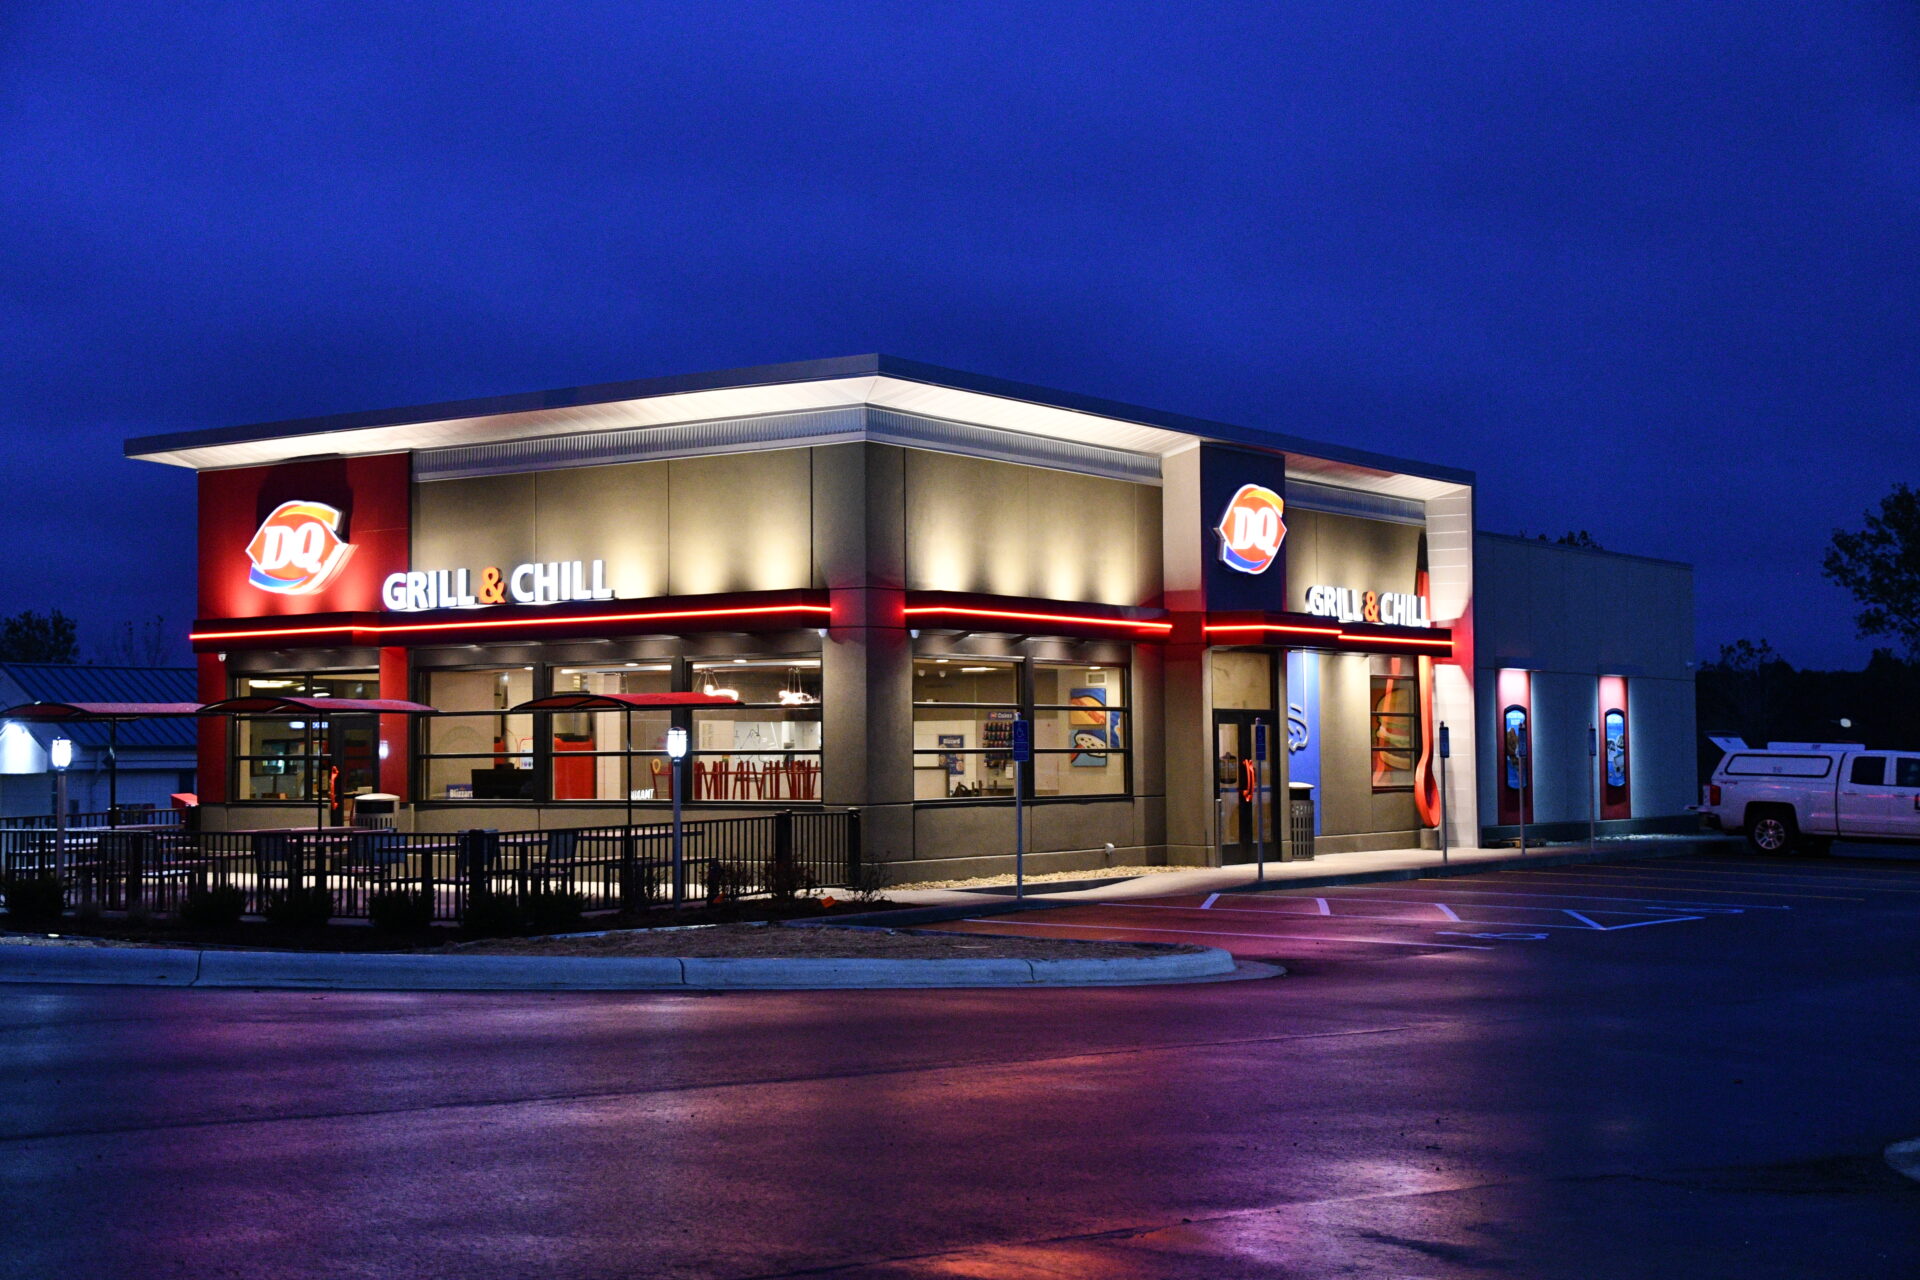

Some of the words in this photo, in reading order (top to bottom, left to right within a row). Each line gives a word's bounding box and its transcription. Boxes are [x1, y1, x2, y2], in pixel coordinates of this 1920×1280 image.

[260, 521, 325, 573] DQ
[1232, 506, 1278, 556] DQ
[382, 568, 475, 611] GRILL
[478, 566, 505, 604] &
[510, 559, 613, 603] CHILL
[1307, 584, 1363, 622] GRILL
[1364, 589, 1379, 623] &
[1380, 591, 1431, 628] CHILL
